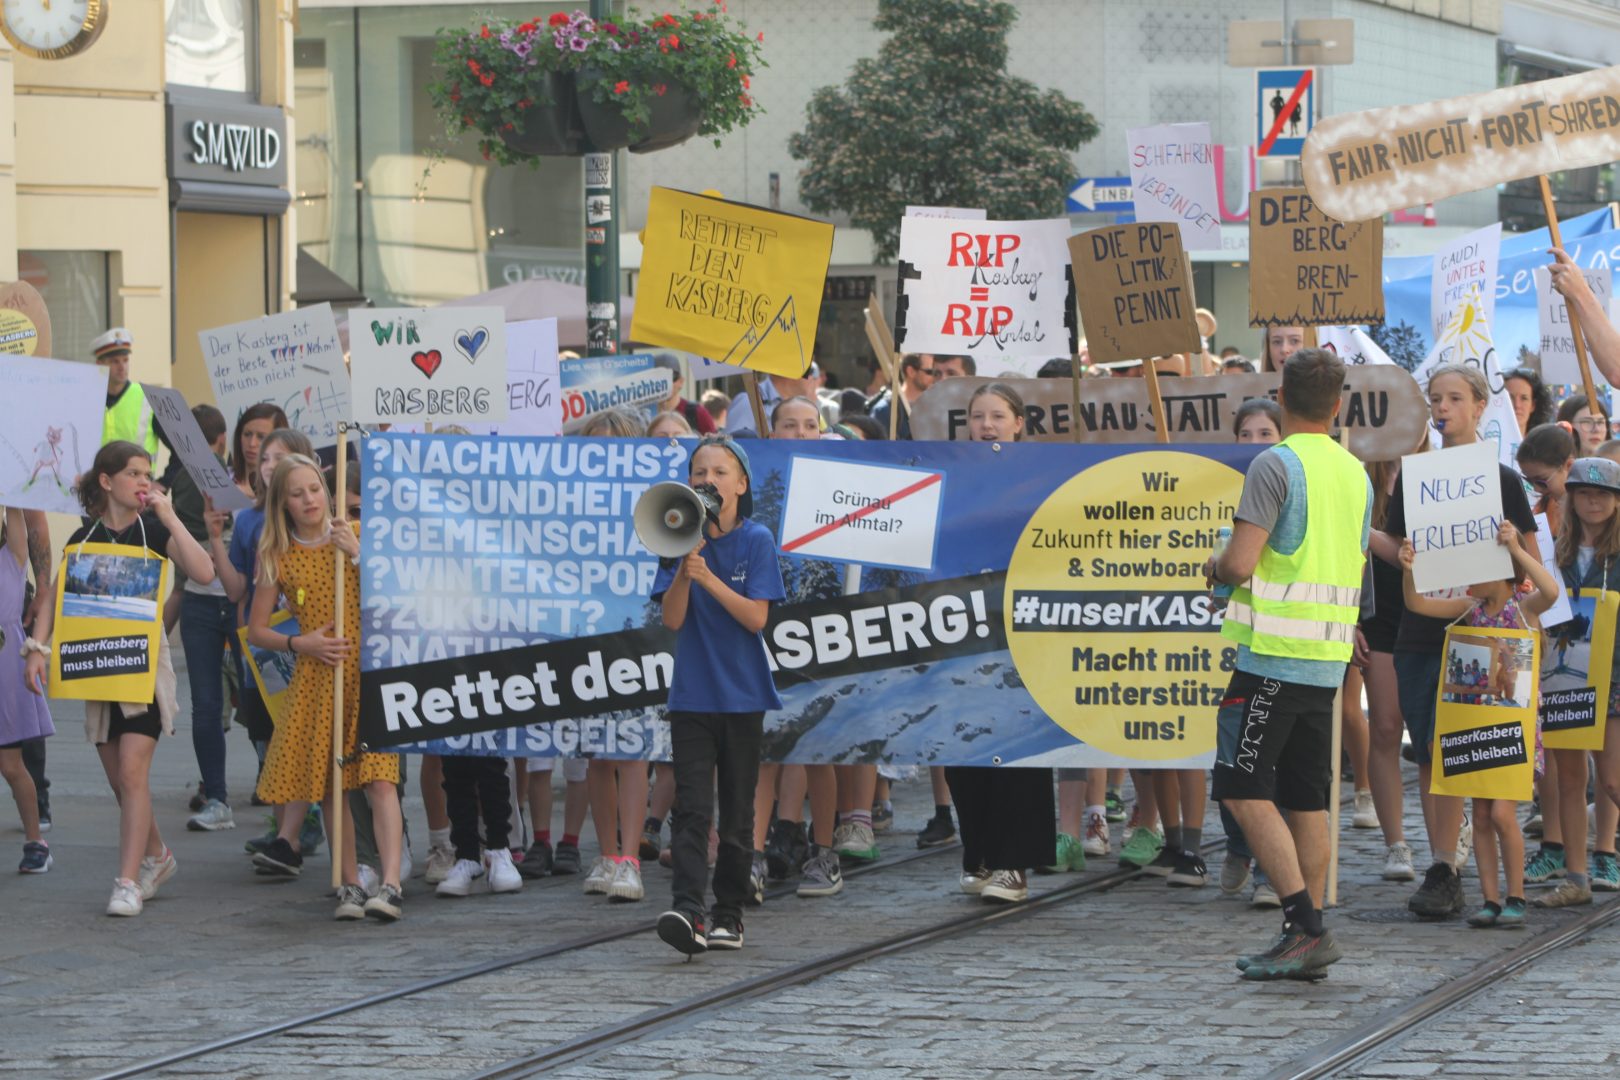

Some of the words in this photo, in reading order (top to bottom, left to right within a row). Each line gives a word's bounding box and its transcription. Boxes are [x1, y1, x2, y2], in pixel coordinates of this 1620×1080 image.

[1134, 143, 1212, 168] SCHIFAHREN
[1328, 144, 1391, 185] FAHR
[1397, 117, 1468, 165] NICHT
[1481, 101, 1545, 149] FORT
[1138, 173, 1220, 233] VERBINDET
[680, 209, 777, 254] RETTET
[1092, 230, 1128, 262] DIE
[1138, 225, 1174, 253] PO-
[1294, 223, 1347, 252] BERG
[690, 243, 744, 284] DEN
[947, 232, 1021, 267] RIP
[1441, 243, 1478, 271] GAUDI
[1116, 256, 1168, 286] LITIK
[1297, 264, 1359, 290] BREN-
[1447, 260, 1486, 285] UNTER
[666, 272, 771, 328] KASBERG
[1114, 287, 1181, 326] PENNT
[1313, 291, 1343, 316] NT
[941, 303, 1014, 336] RIP
[208, 336, 231, 357] Der
[236, 332, 289, 352] Kasberg
[293, 321, 309, 336] ist
[214, 364, 231, 378] der
[239, 356, 267, 374] Beste
[238, 377, 259, 390] uns
[265, 366, 296, 385] nicht
[375, 386, 490, 416] KASBERG
[367, 438, 687, 478] ?NACHWUCHS?
[1142, 471, 1180, 493] Wir
[1420, 474, 1486, 505] NEUES
[832, 489, 891, 511] Grünau
[1083, 501, 1155, 521] wollen
[1160, 501, 1211, 521] auch
[1217, 501, 1235, 520] in
[815, 509, 835, 526] im
[840, 513, 903, 534] Almtal?
[1031, 528, 1113, 549] Zukunft
[1119, 529, 1161, 549] hier
[1067, 557, 1084, 577] &
[367, 595, 605, 634] ?ZUKUNFT?
[60, 637, 148, 655] #unserKasberg
[1072, 646, 1157, 673] Macht
[1165, 645, 1212, 672] mit
[63, 659, 94, 672] muss
[96, 653, 146, 668] bleiben!
[380, 661, 560, 732] Rettet
[571, 651, 674, 702] den
[1124, 715, 1185, 741] uns!
[1547, 708, 1593, 723] bleiben!
[1441, 725, 1522, 749] #unserKasberg
[1444, 754, 1470, 767] muss
[1472, 742, 1523, 762] bleiben!
